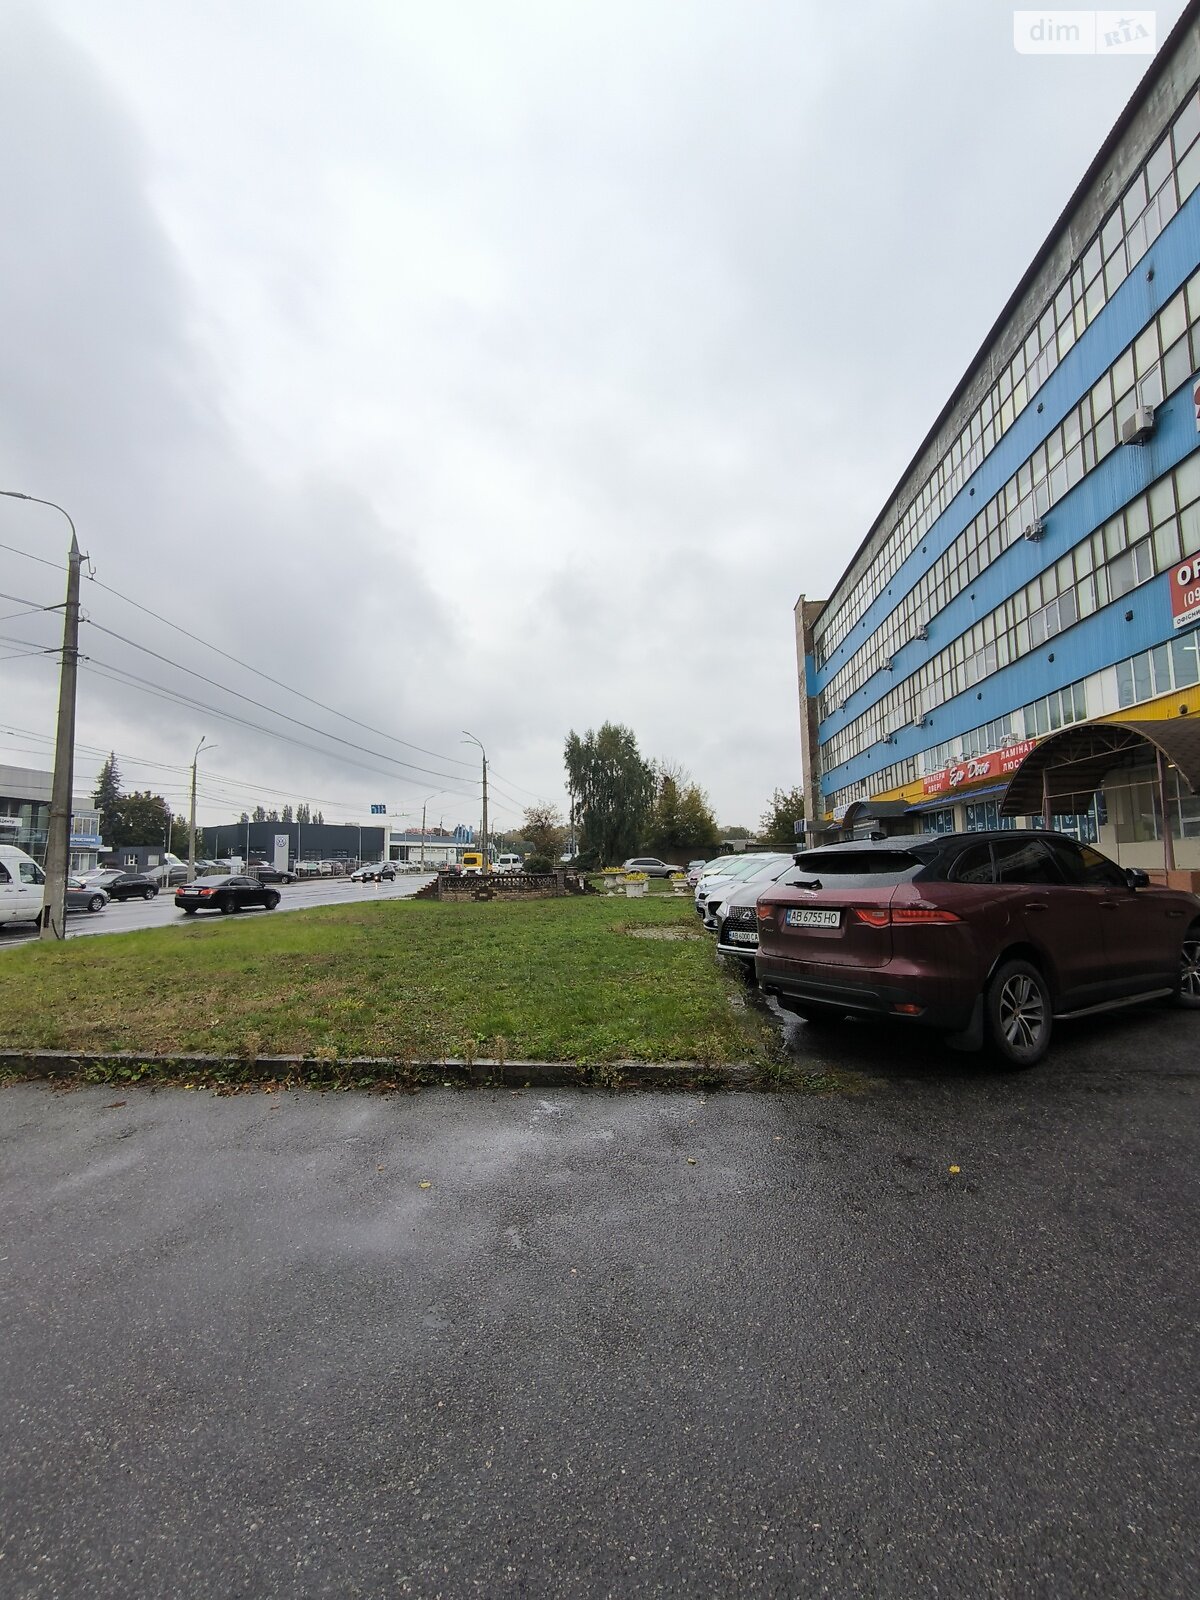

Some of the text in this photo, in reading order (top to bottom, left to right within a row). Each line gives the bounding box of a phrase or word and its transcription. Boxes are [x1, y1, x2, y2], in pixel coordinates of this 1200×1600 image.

[1000, 741, 1034, 760] ЛАМІНАТ
[928, 783, 942, 795] ДВЕРІ
[791, 911, 837, 924] AB 6755 HO
